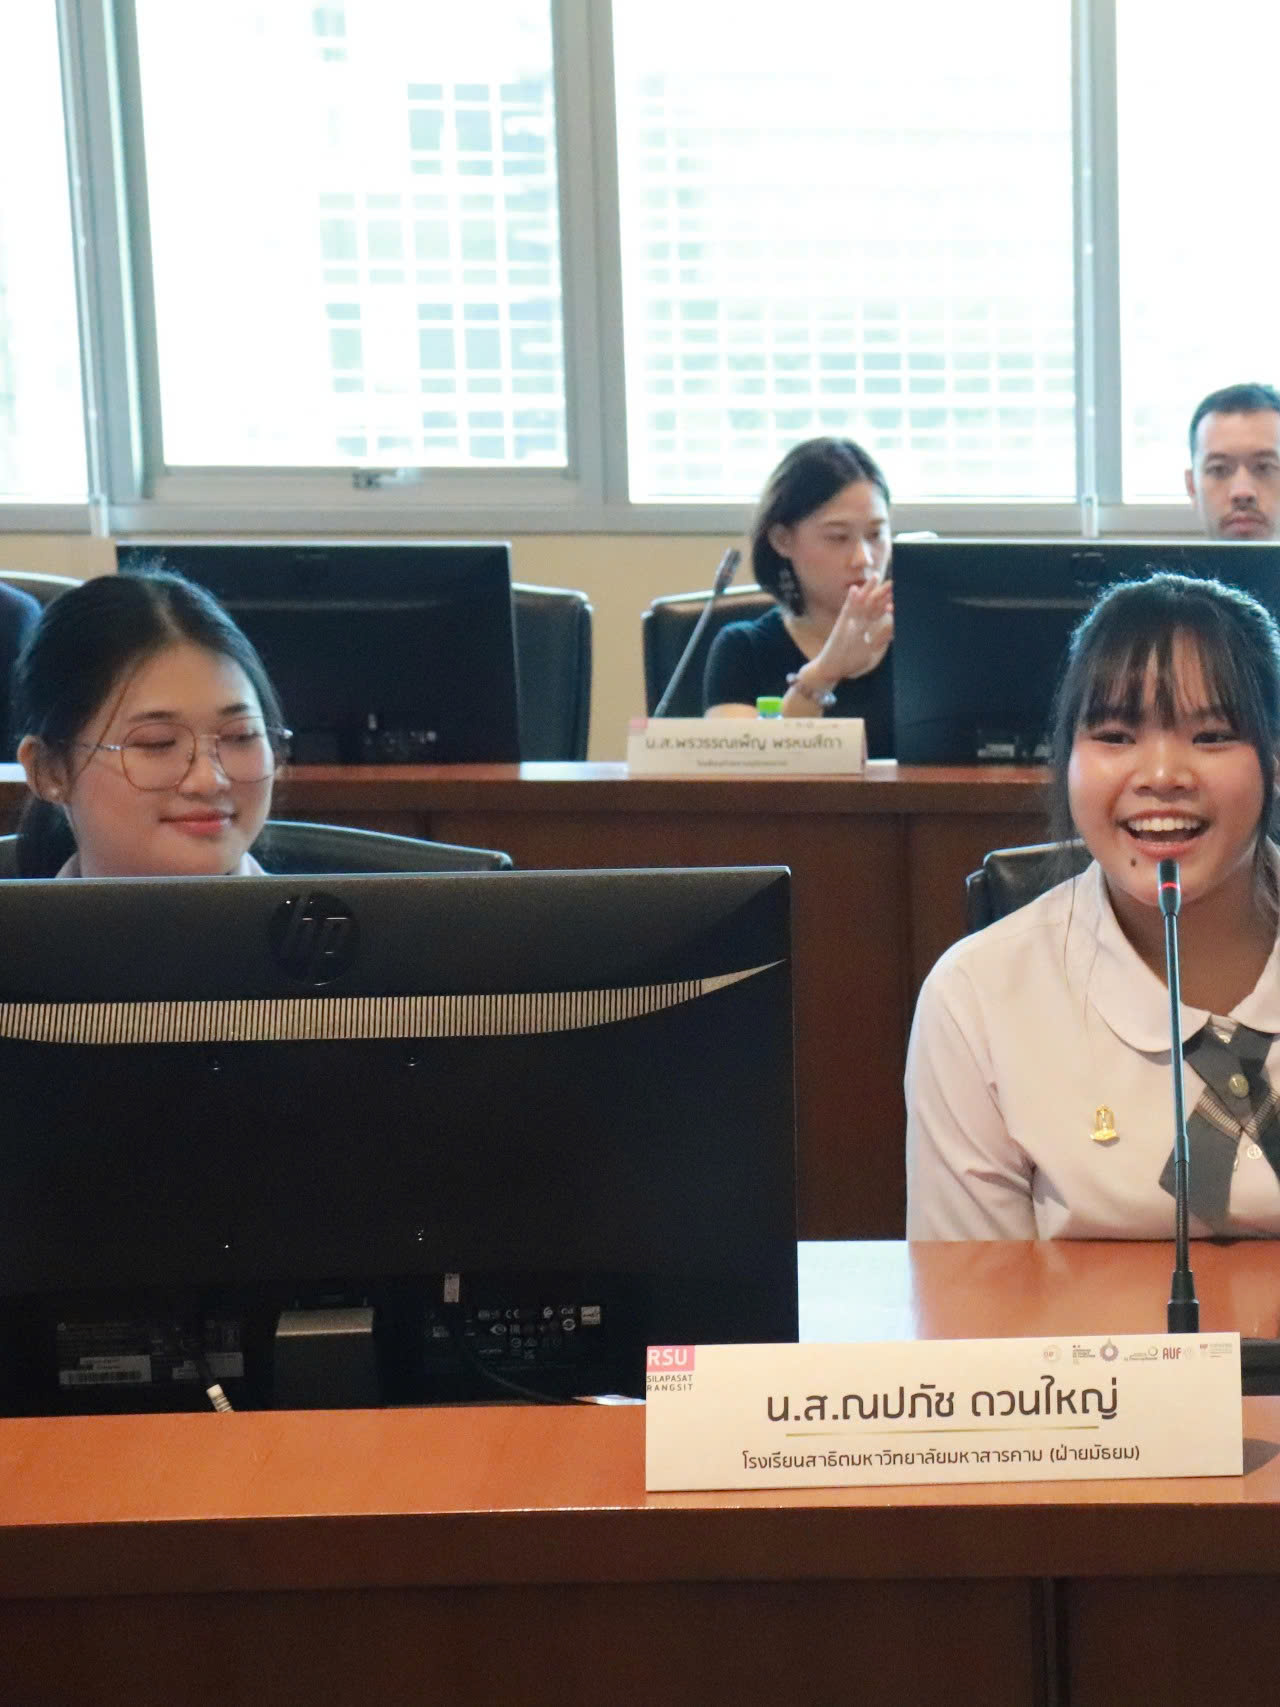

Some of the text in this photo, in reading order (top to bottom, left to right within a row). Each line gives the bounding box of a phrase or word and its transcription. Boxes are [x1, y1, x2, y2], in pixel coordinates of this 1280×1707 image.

[648, 1348, 688, 1366] RSU
[647, 1374, 693, 1383] SILAPASAT
[647, 1383, 693, 1392] RANGSIT
[767, 1375, 1118, 1422] น.ส.ณปภัช ดวนใหญ่
[742, 1444, 1140, 1469] โรงเรียนสาธิตมหาวิทยาลัยมหาสารคาม (ฝ่ายมัธยม)
